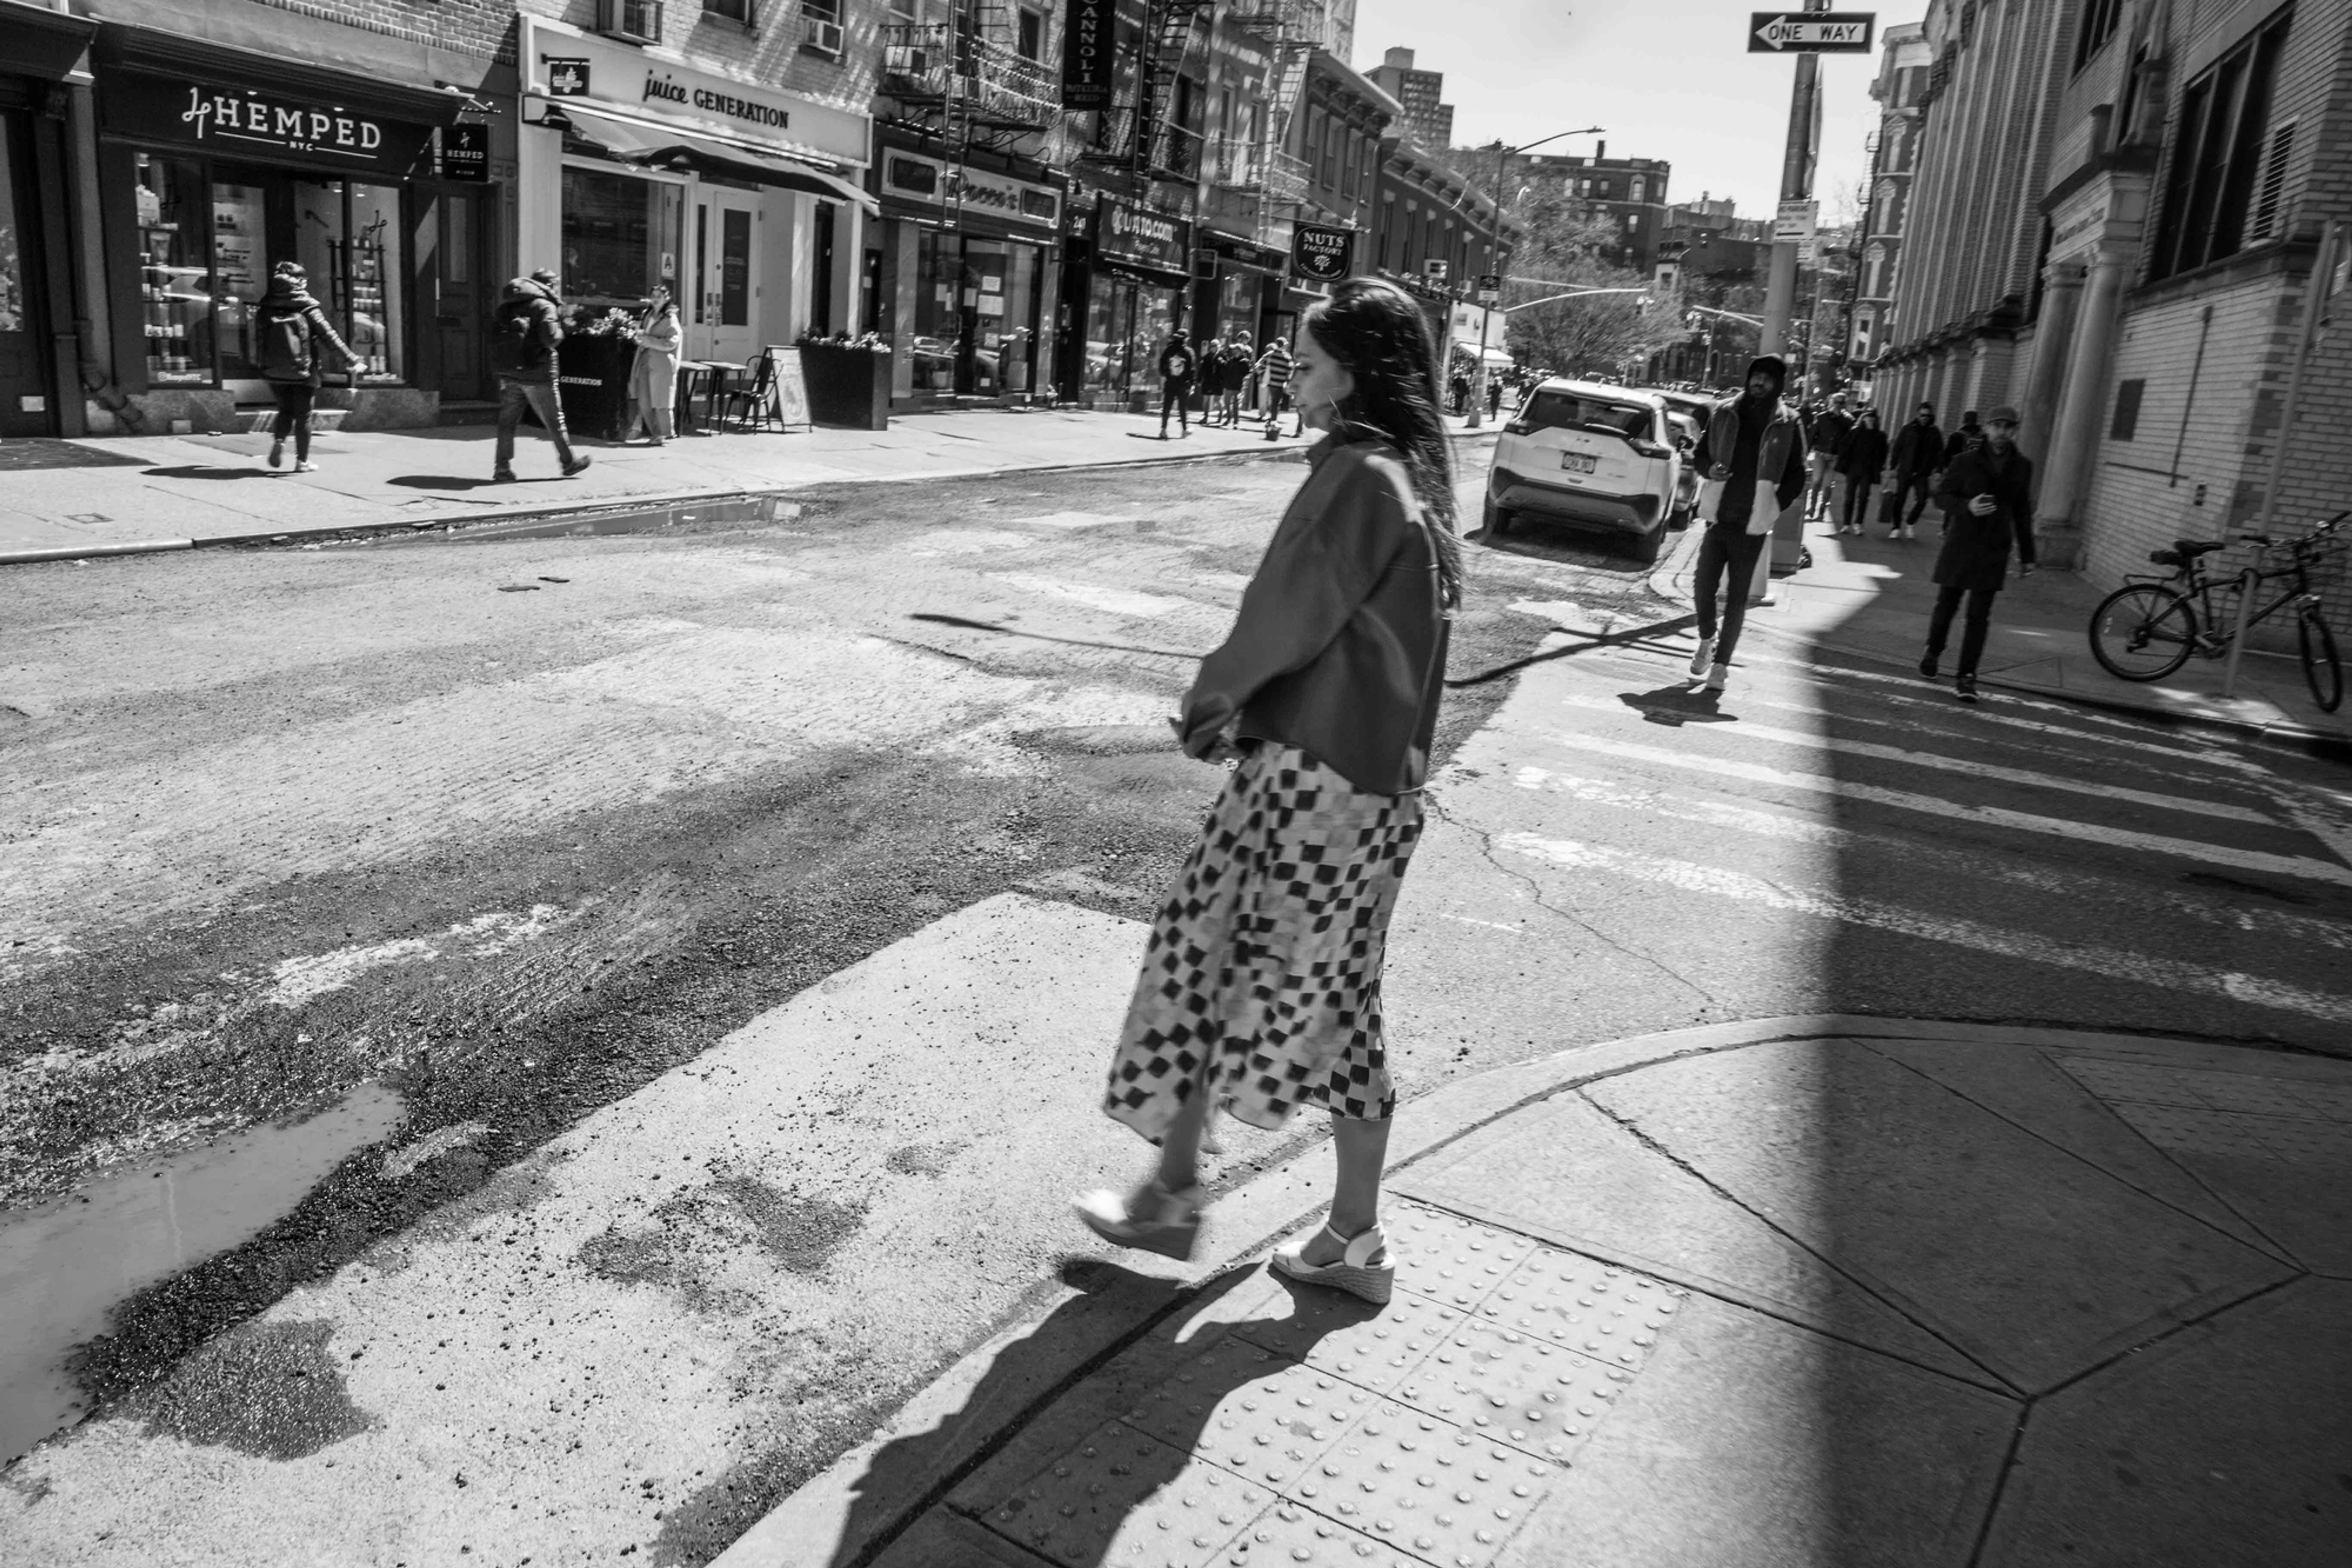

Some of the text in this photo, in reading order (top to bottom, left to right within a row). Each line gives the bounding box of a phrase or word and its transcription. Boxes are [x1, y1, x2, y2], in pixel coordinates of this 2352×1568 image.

[1769, 24, 1858, 40] ONE WAY
[643, 69, 790, 129] juice GENERATION
[214, 95, 381, 149] HEMPED
[289, 141, 313, 151] NYC
[447, 150, 484, 159] HEMPED
[1304, 232, 1344, 248] NUTS
[1303, 243, 1342, 256] FACTORY
[664, 256, 672, 270] A
[560, 376, 602, 386] GENERATION
